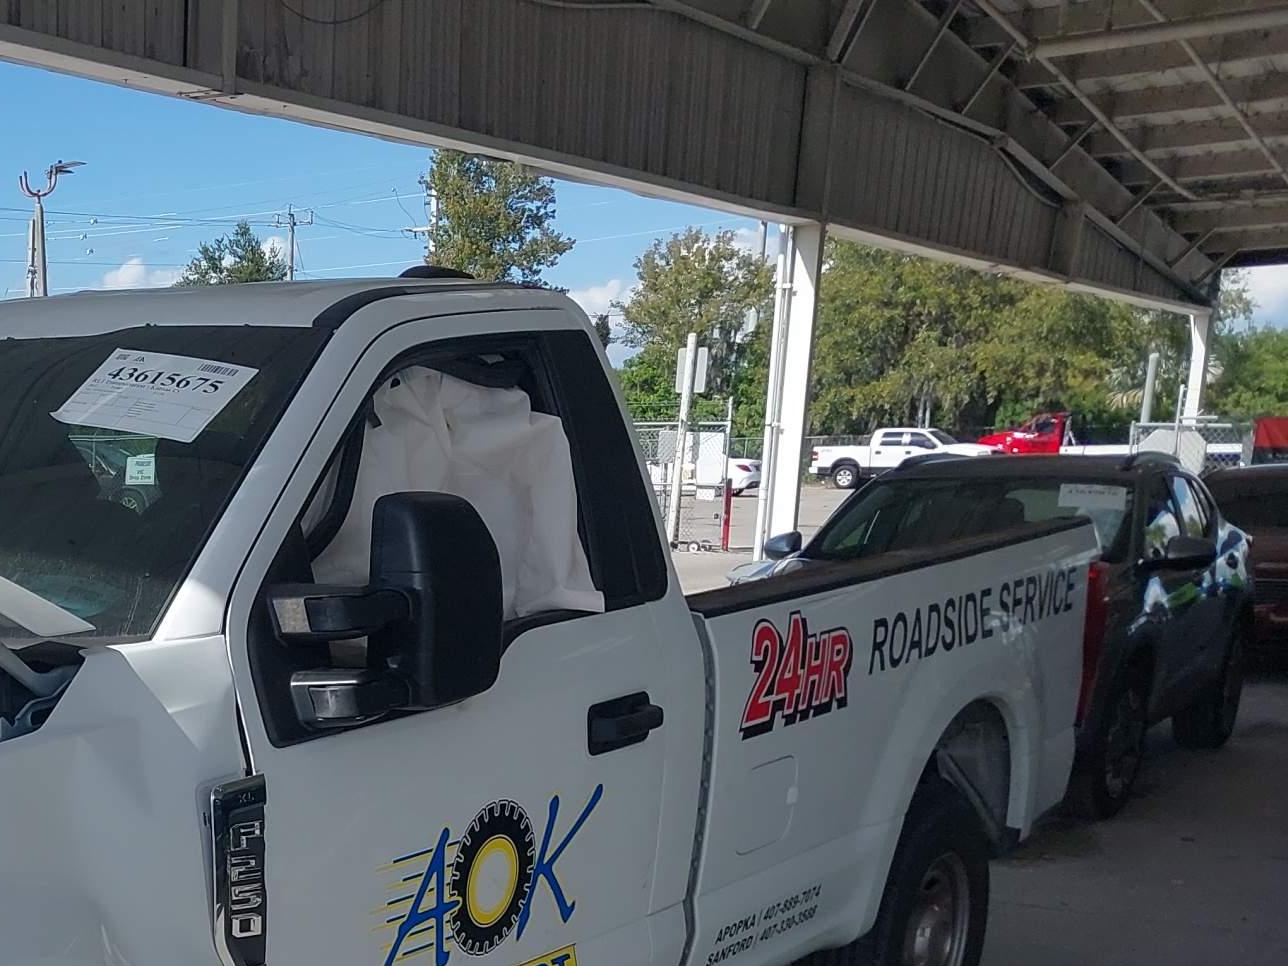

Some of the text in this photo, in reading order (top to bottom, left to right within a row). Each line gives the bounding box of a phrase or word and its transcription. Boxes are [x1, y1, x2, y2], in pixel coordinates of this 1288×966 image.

[108, 366, 224, 394] 43615675
[868, 566, 1078, 675] ROADSIDE SERVICE
[740, 610, 853, 740] 24HR
[714, 913, 757, 945] APOPKA
